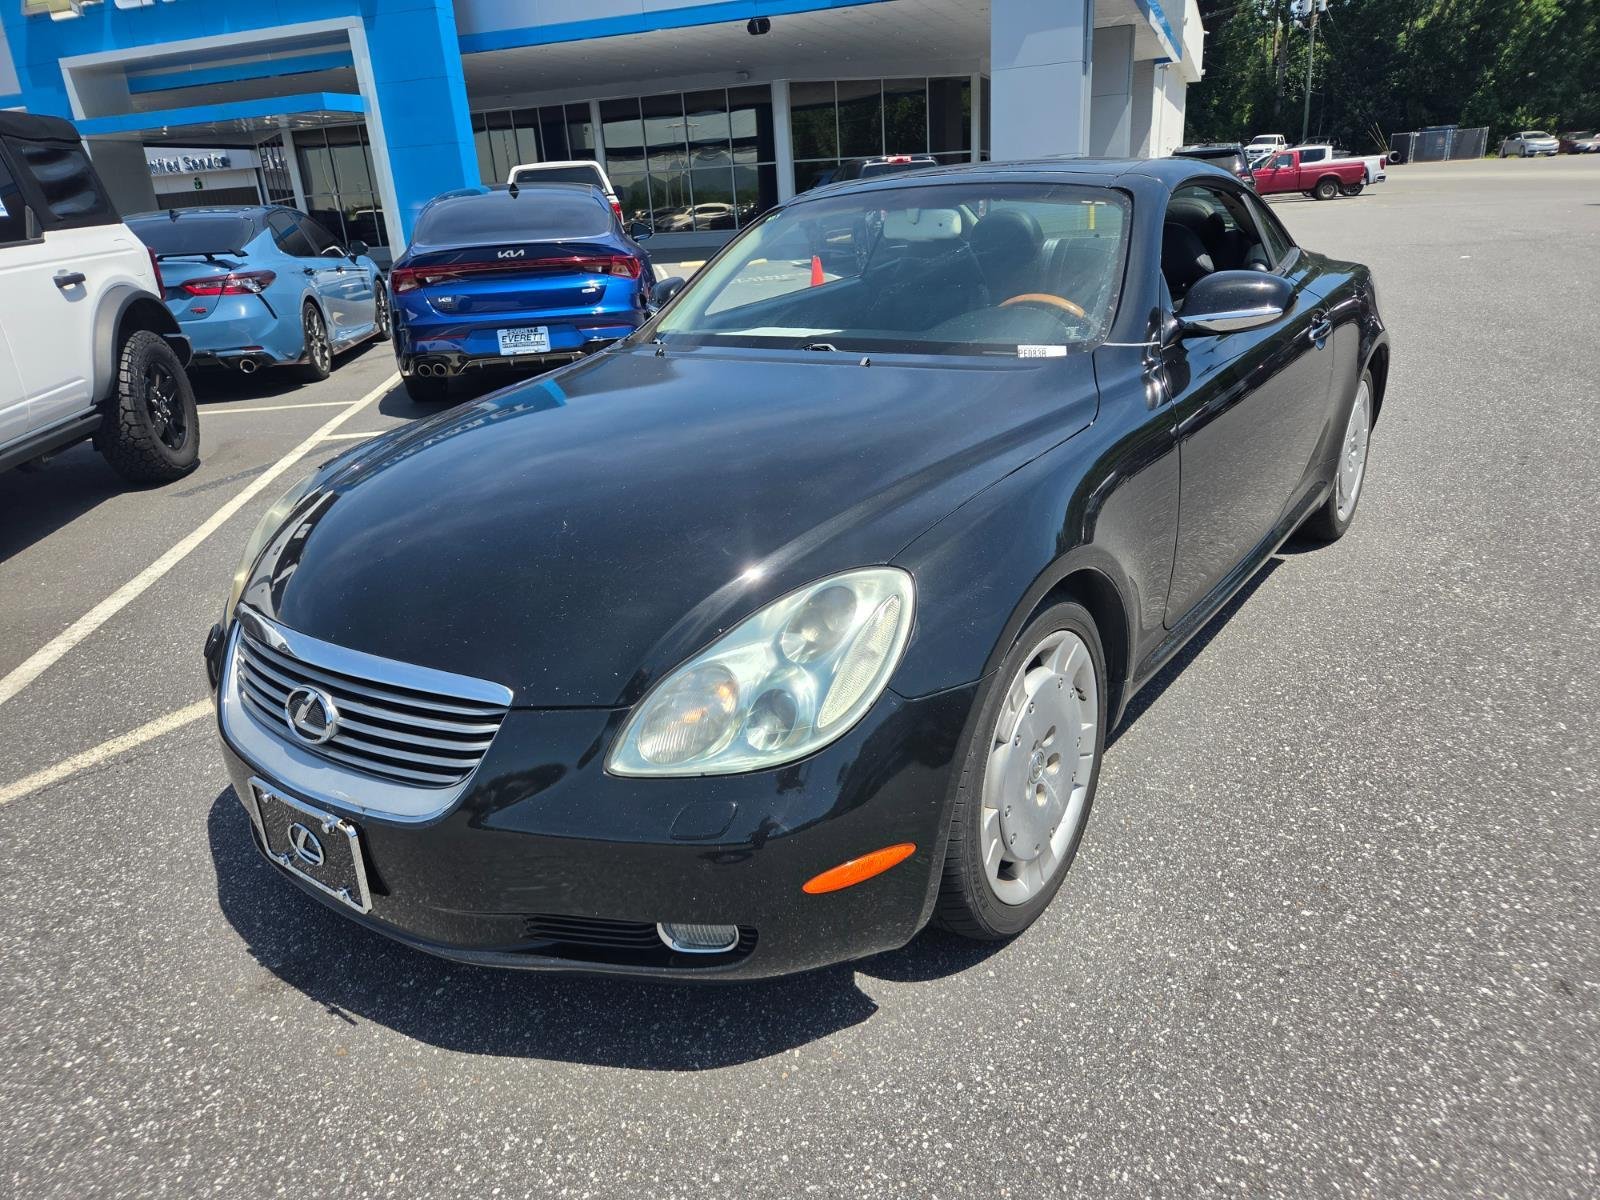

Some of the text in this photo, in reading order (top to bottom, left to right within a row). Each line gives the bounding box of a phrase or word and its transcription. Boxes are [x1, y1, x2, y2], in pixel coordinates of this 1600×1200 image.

[183, 154, 231, 172] Service
[498, 249, 525, 259] KIA
[501, 332, 545, 343] EVERETT
